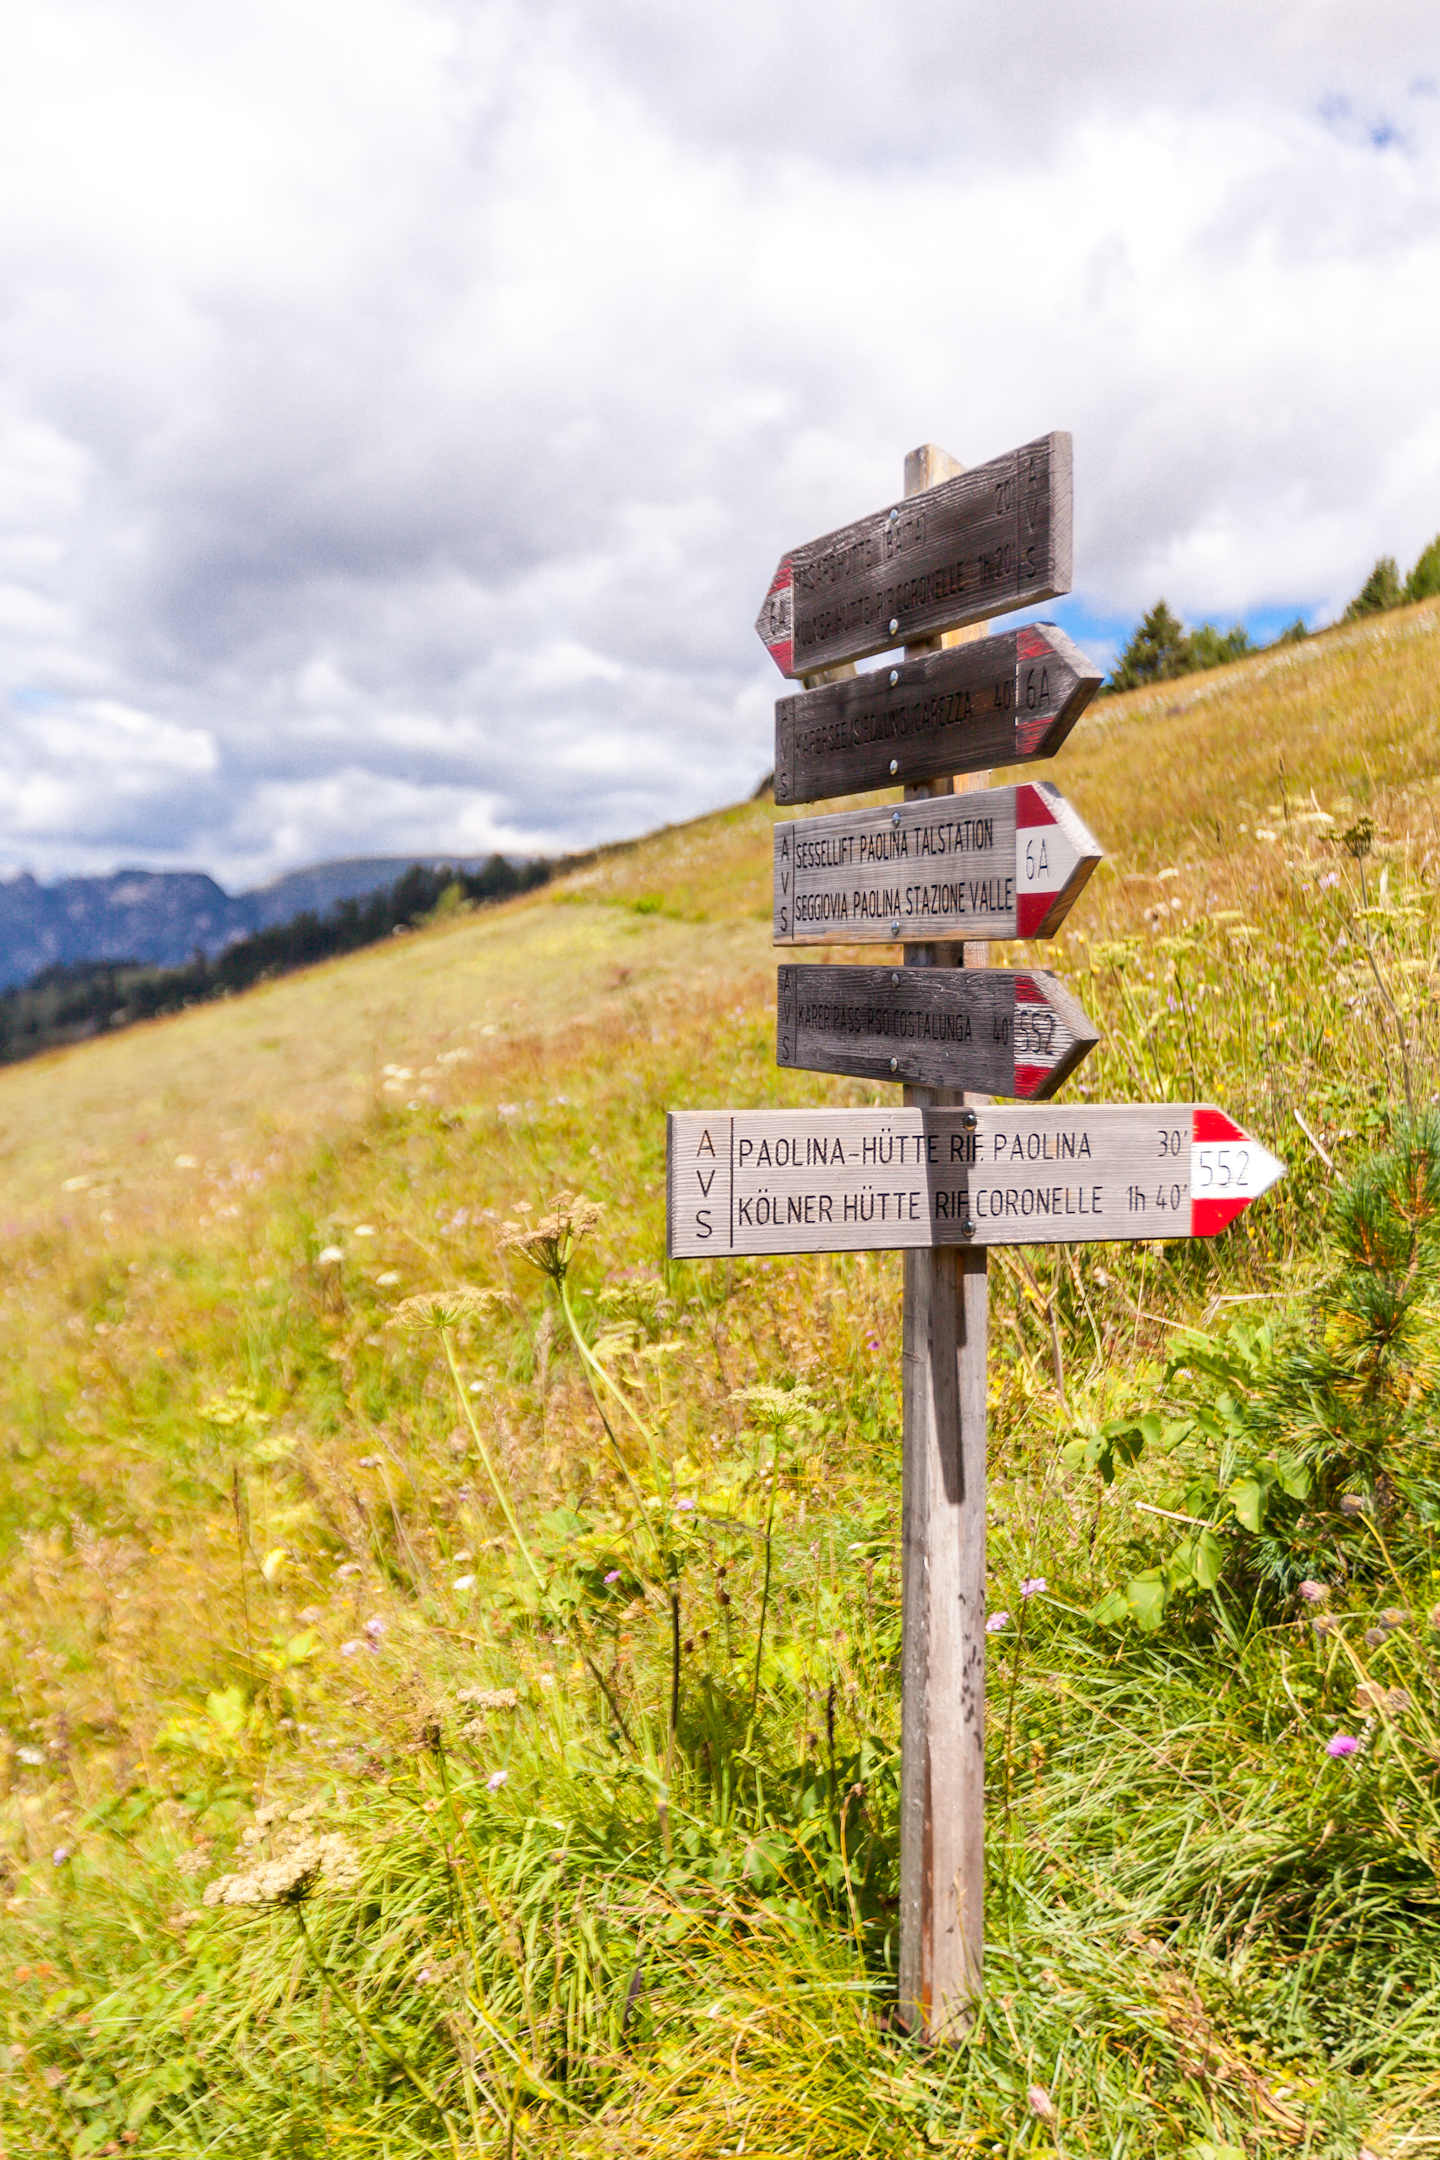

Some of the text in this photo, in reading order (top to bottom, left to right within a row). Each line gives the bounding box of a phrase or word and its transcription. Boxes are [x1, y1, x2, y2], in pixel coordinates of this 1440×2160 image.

[1026, 665, 1050, 710] 6A
[796, 818, 993, 869] SESSELLIFT PAOLINA TALSTATION
[1026, 838, 1049, 880] 6A
[795, 878, 1013, 921] SEGGIOVIA PAOLINA STAZIONE VALLE
[1017, 1009, 1057, 1056] 552
[739, 1127, 1187, 1168] PAOLINA-HÜTTE RIF. PAOLINA 30'
[1199, 1150, 1249, 1187] 552
[738, 1187, 833, 1226] KÖLNER
[843, 1185, 921, 1222] HÜTTE
[976, 1186, 1103, 1217] CORONELLE
[1128, 1185, 1146, 1212] 1h
[1156, 1184, 1187, 1211] 40'
